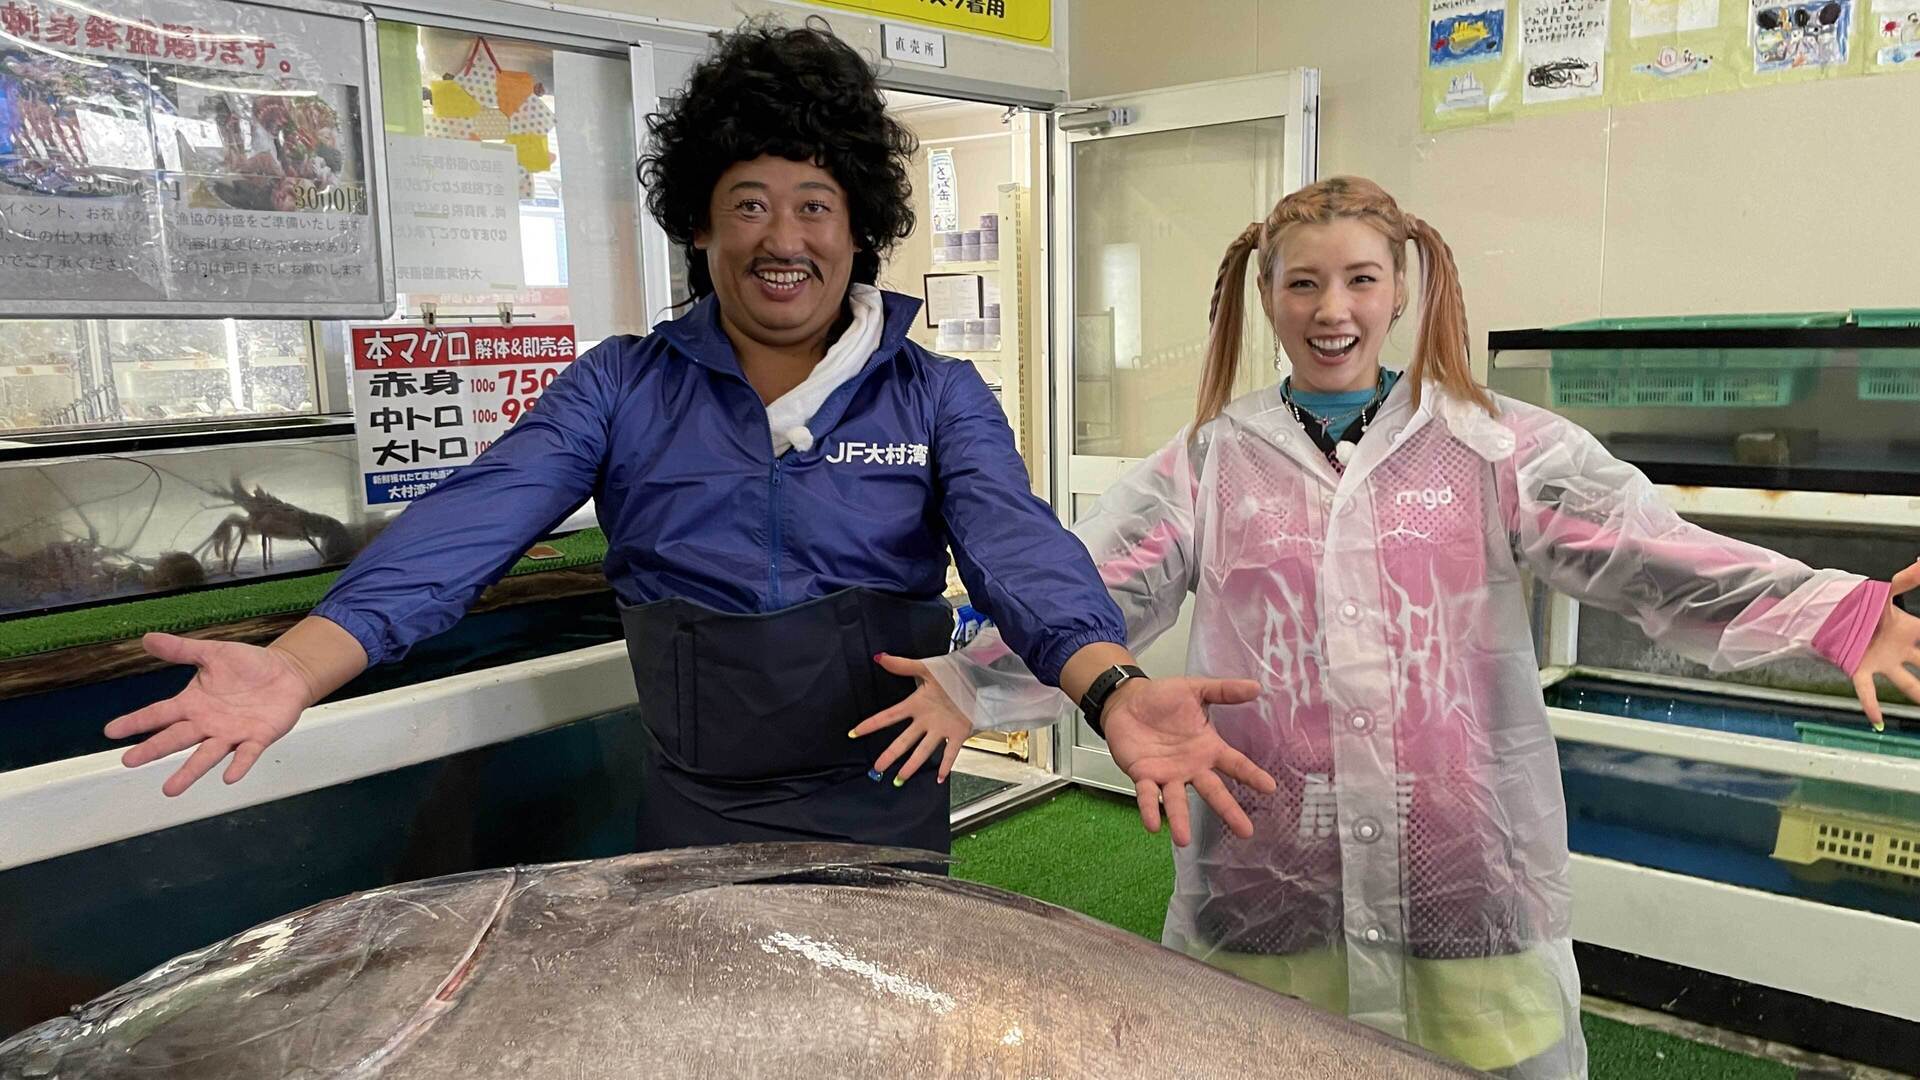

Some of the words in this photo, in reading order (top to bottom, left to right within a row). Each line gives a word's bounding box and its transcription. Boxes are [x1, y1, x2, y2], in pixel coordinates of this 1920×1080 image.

[895, 36, 934, 57] 直売所
[936, 166, 951, 201] さば缶
[364, 330, 470, 367] 本マグロ
[474, 336, 574, 360] 解体&即売会
[370, 370, 465, 398] 赤身
[471, 378, 496, 393] 100g
[370, 405, 464, 433] 中トロ
[472, 409, 498, 424] 100g
[373, 436, 468, 466] 大トロ
[825, 441, 929, 467] JF大村湾
[1396, 485, 1453, 511] mgd
